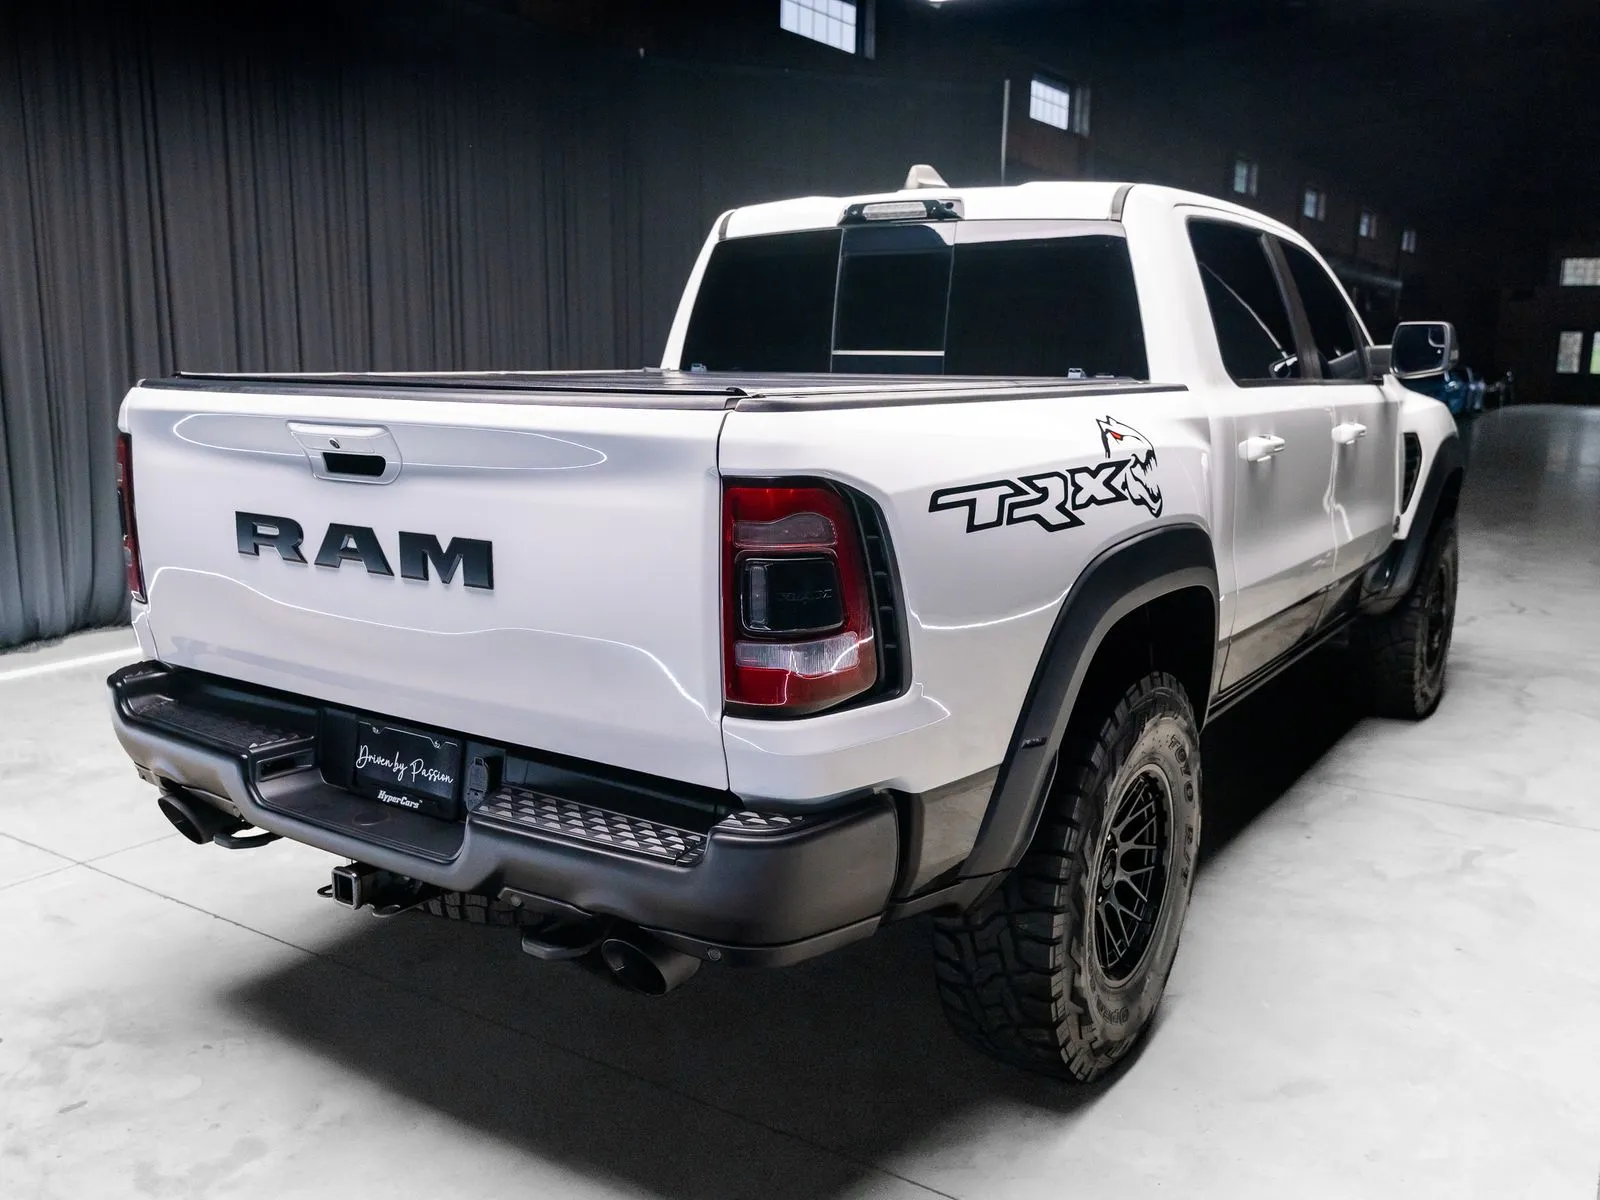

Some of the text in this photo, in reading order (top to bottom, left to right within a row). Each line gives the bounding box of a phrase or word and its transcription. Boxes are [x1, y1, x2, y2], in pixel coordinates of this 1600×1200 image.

[928, 458, 1132, 534] TRX
[235, 510, 494, 590] RAM
[355, 744, 454, 784] Driven by Passion
[1168, 734, 1194, 803] TOYO
[377, 789, 420, 809] HyperCars
